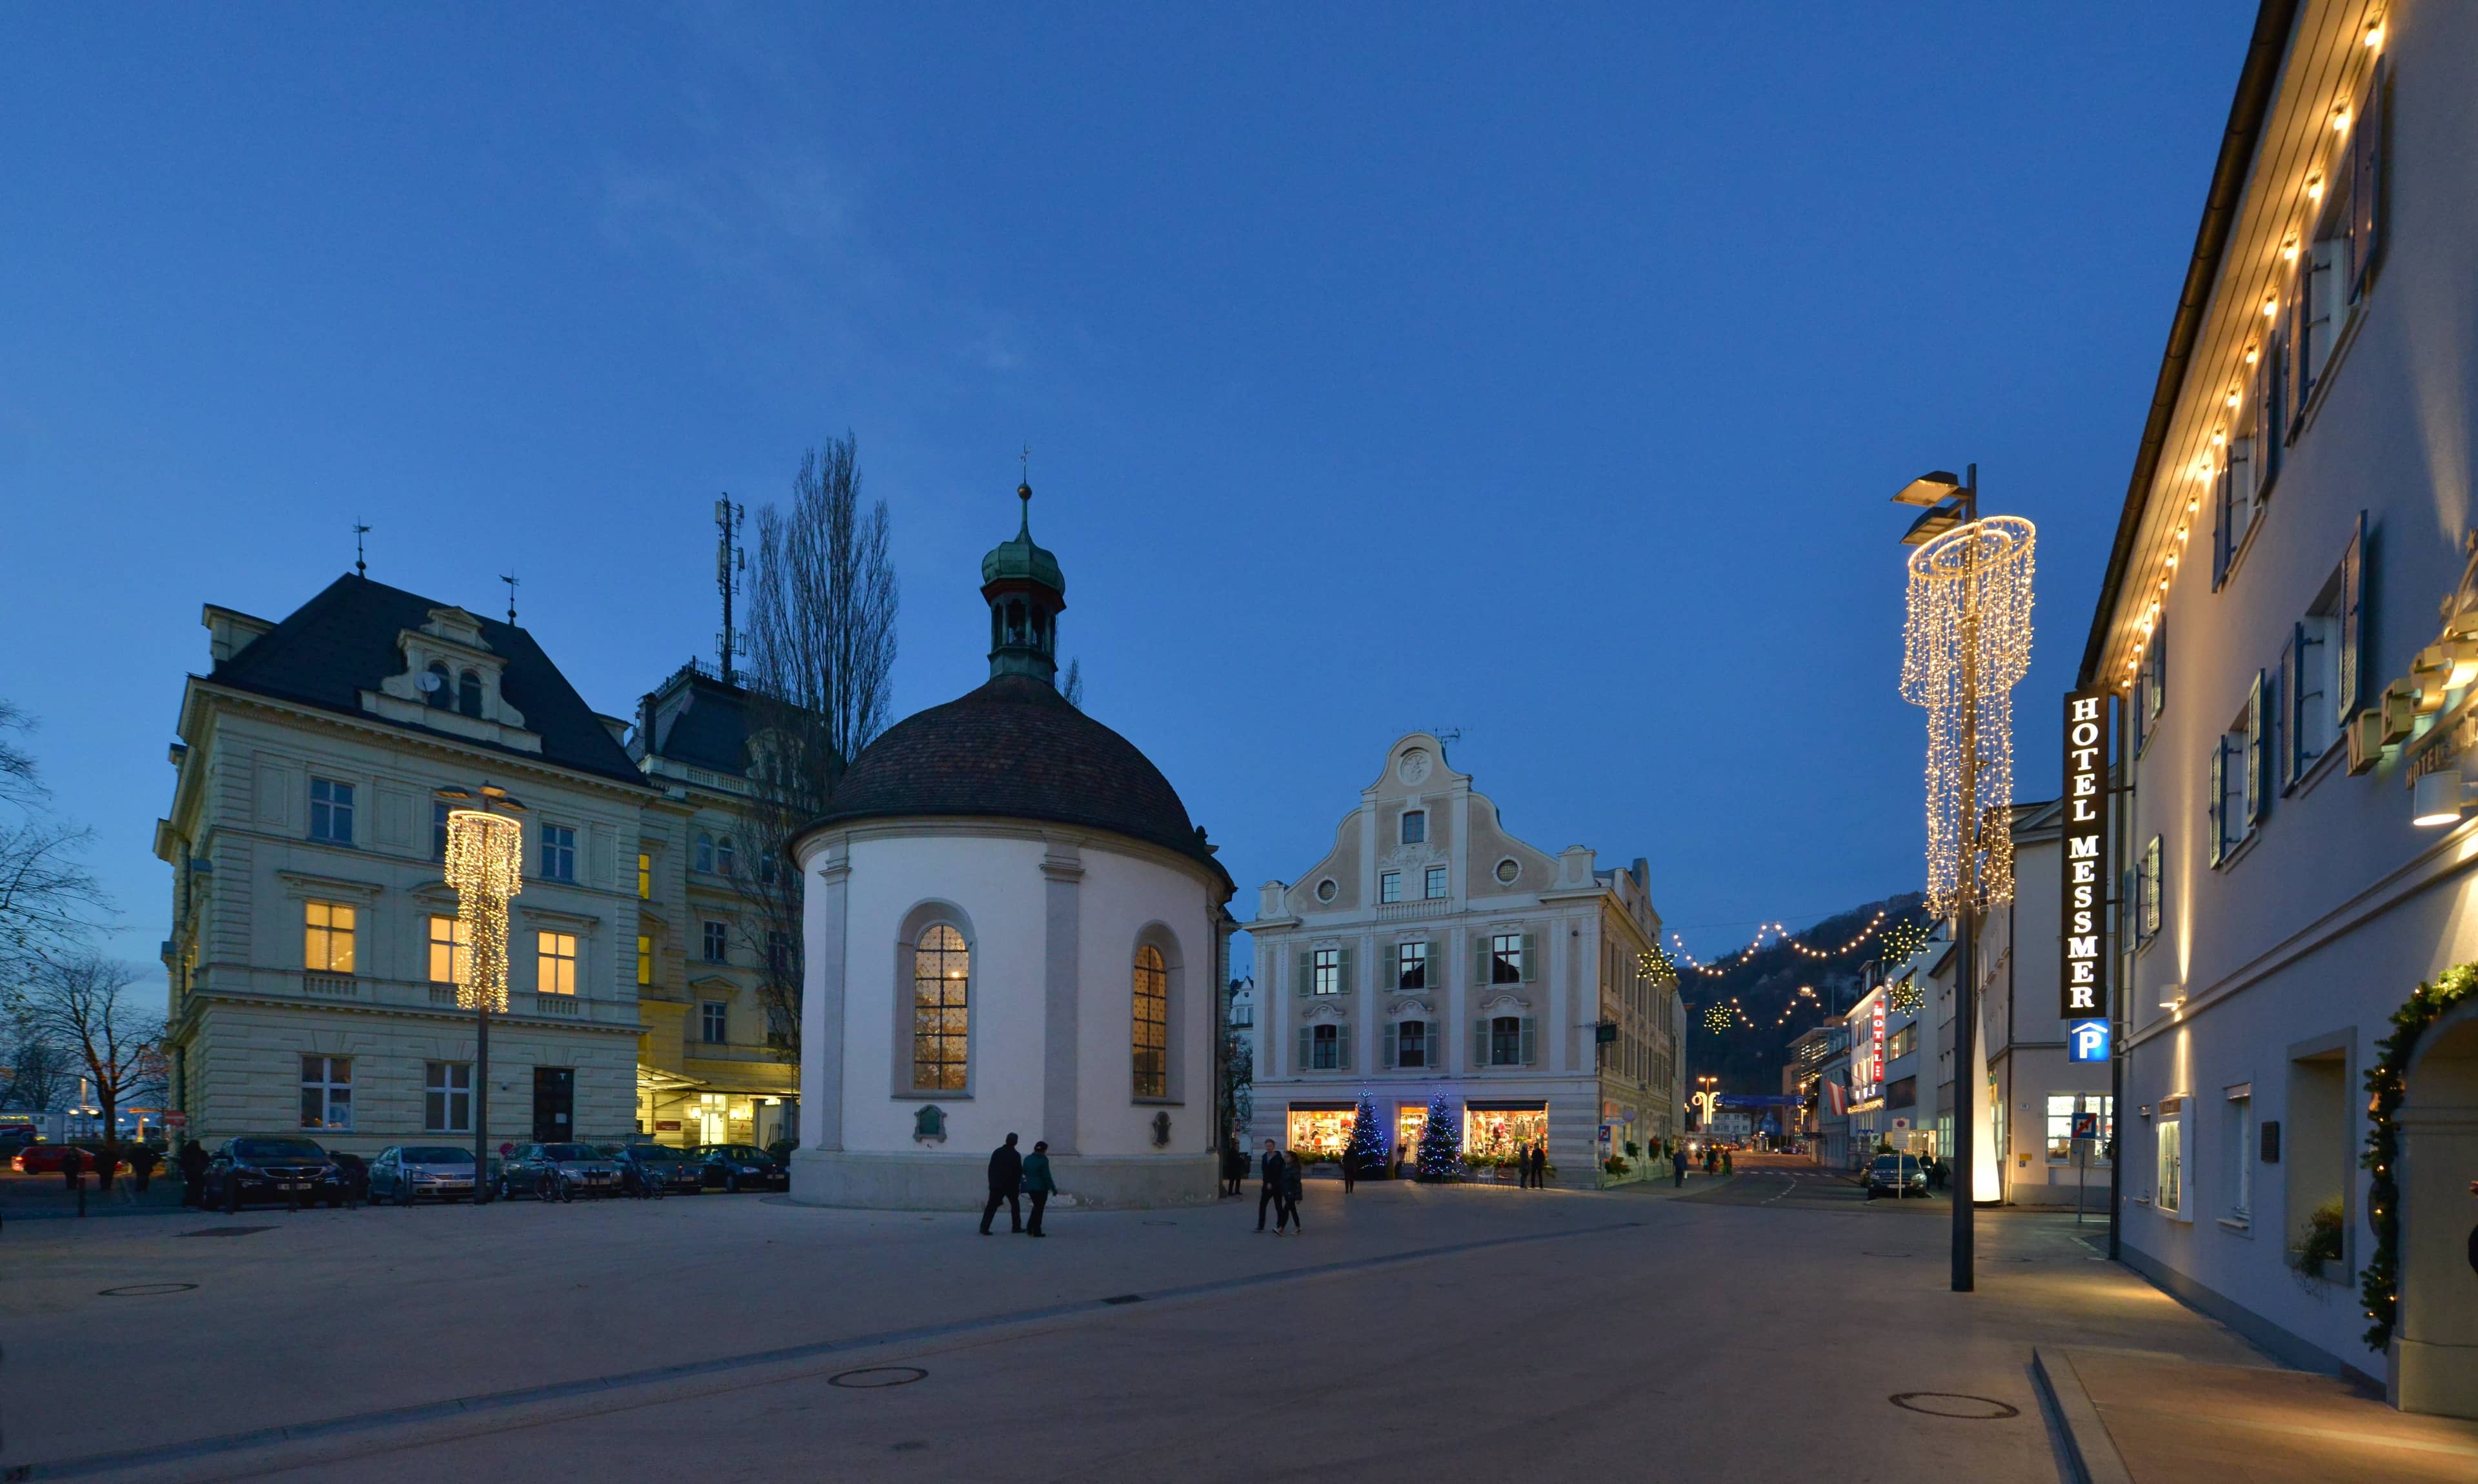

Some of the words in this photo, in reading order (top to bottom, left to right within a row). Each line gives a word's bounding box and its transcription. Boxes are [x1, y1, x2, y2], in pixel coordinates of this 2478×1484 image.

[2071, 697, 2099, 821] HOTEL
[2068, 835, 2099, 1008] MESSMER
[1873, 1007, 1883, 1062] HOTEL
[2079, 1032, 2102, 1059] P
